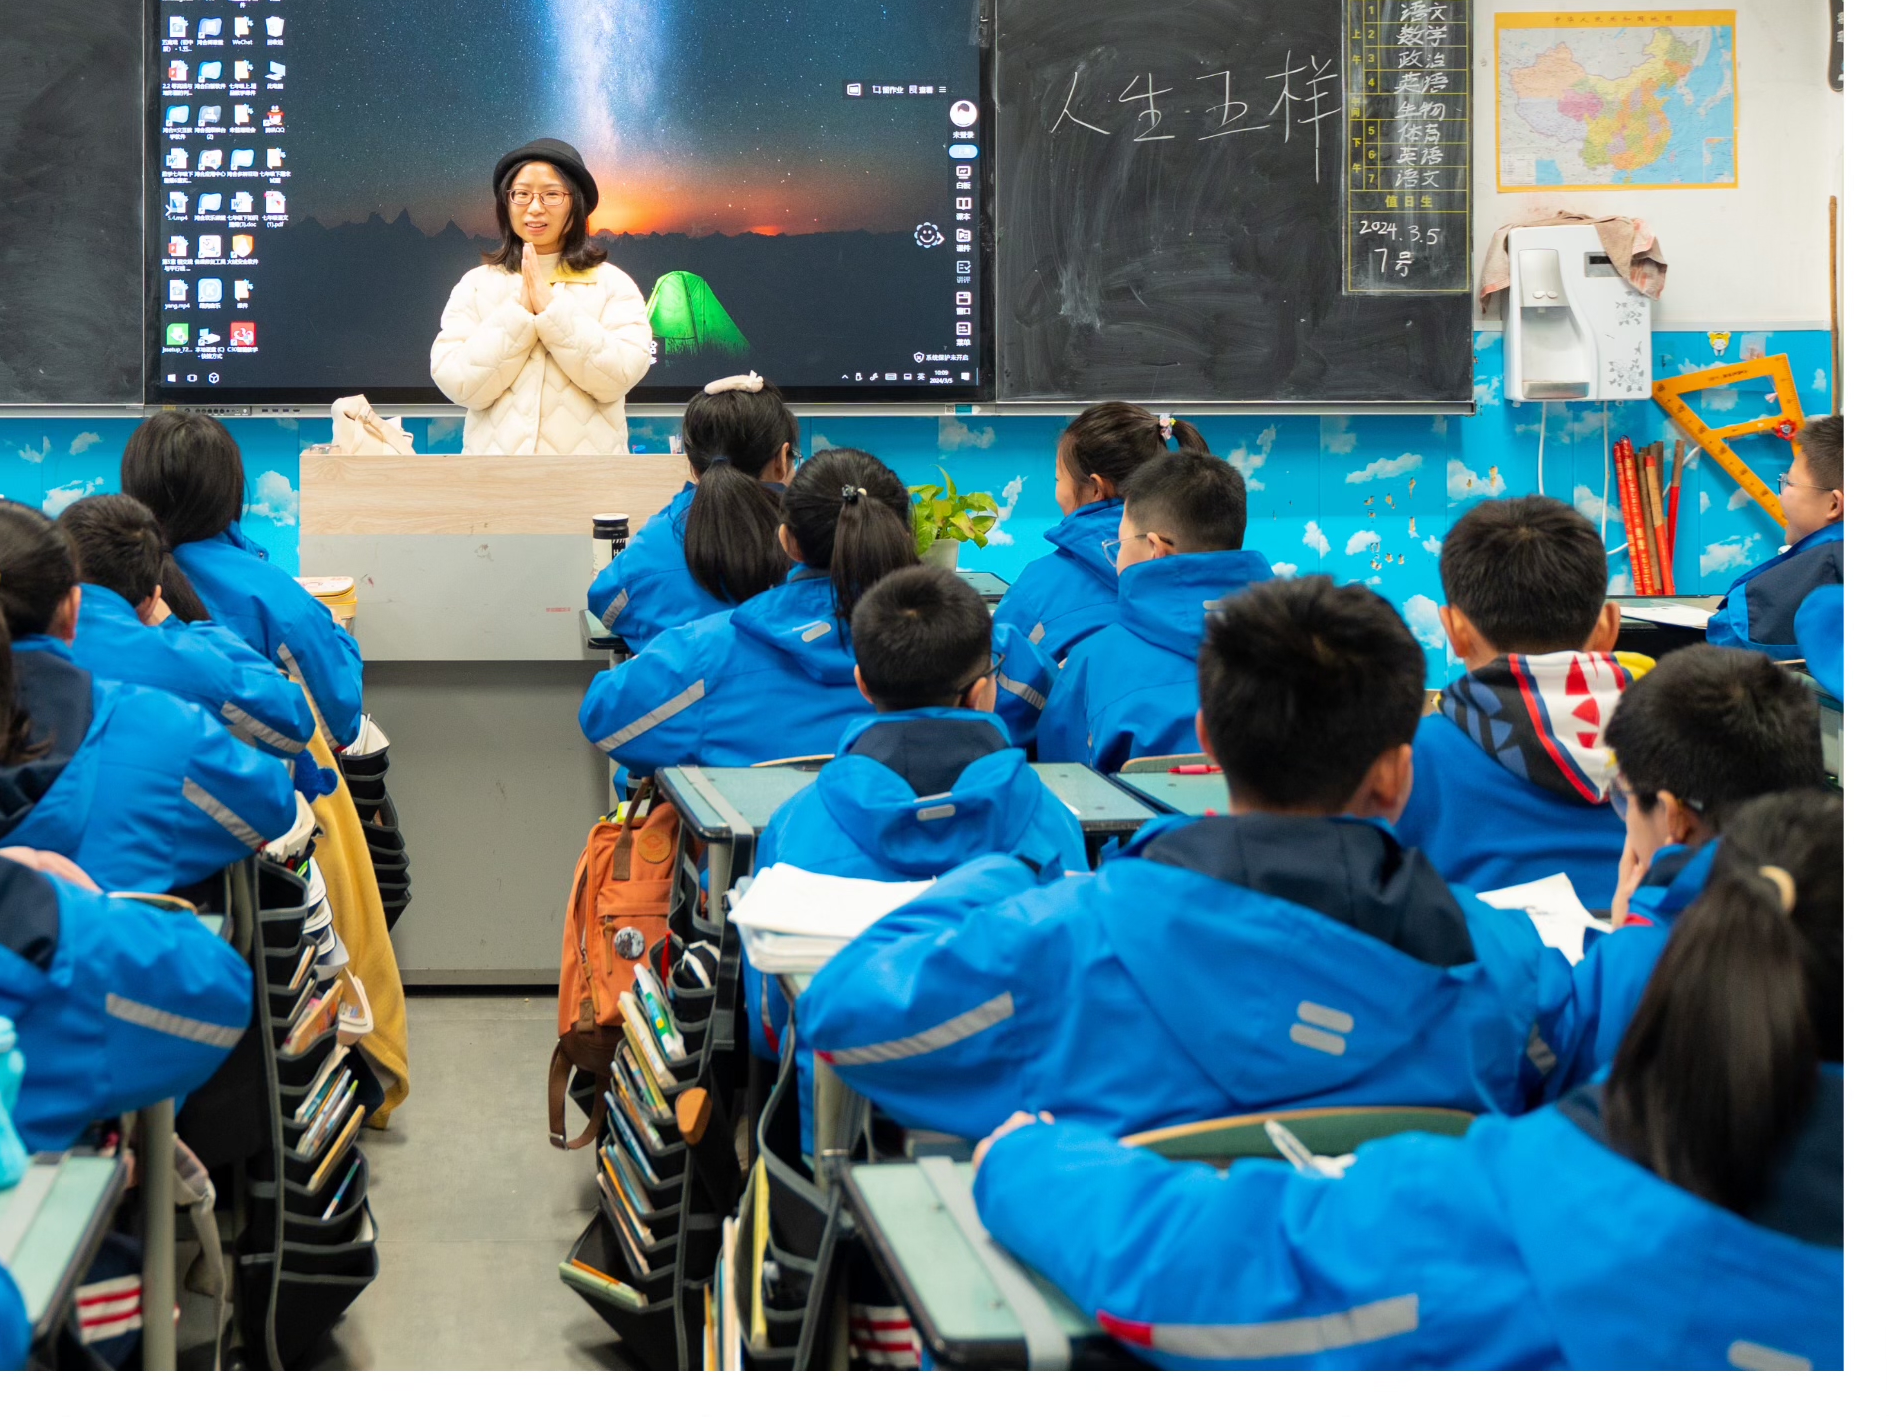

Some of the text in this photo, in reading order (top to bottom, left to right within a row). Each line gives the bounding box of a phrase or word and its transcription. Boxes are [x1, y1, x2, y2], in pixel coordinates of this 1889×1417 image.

[1368, 5, 1374, 15] 1
[1400, 0, 1448, 22] 语文
[1368, 30, 1375, 39] 2
[1395, 23, 1448, 47] 数学
[1368, 54, 1375, 63] 3
[1397, 49, 1445, 69] 政治
[1368, 77, 1376, 87] 4
[1052, 50, 1341, 183] 人生五样
[1394, 101, 1446, 122] 生物
[1368, 126, 1375, 135] 5
[1397, 122, 1441, 145] 体育
[1368, 149, 1376, 159] 6
[1396, 146, 1444, 166] 英语
[1368, 174, 1375, 184] 7
[1395, 168, 1440, 188] 语文
[1385, 195, 1433, 208] 值日生
